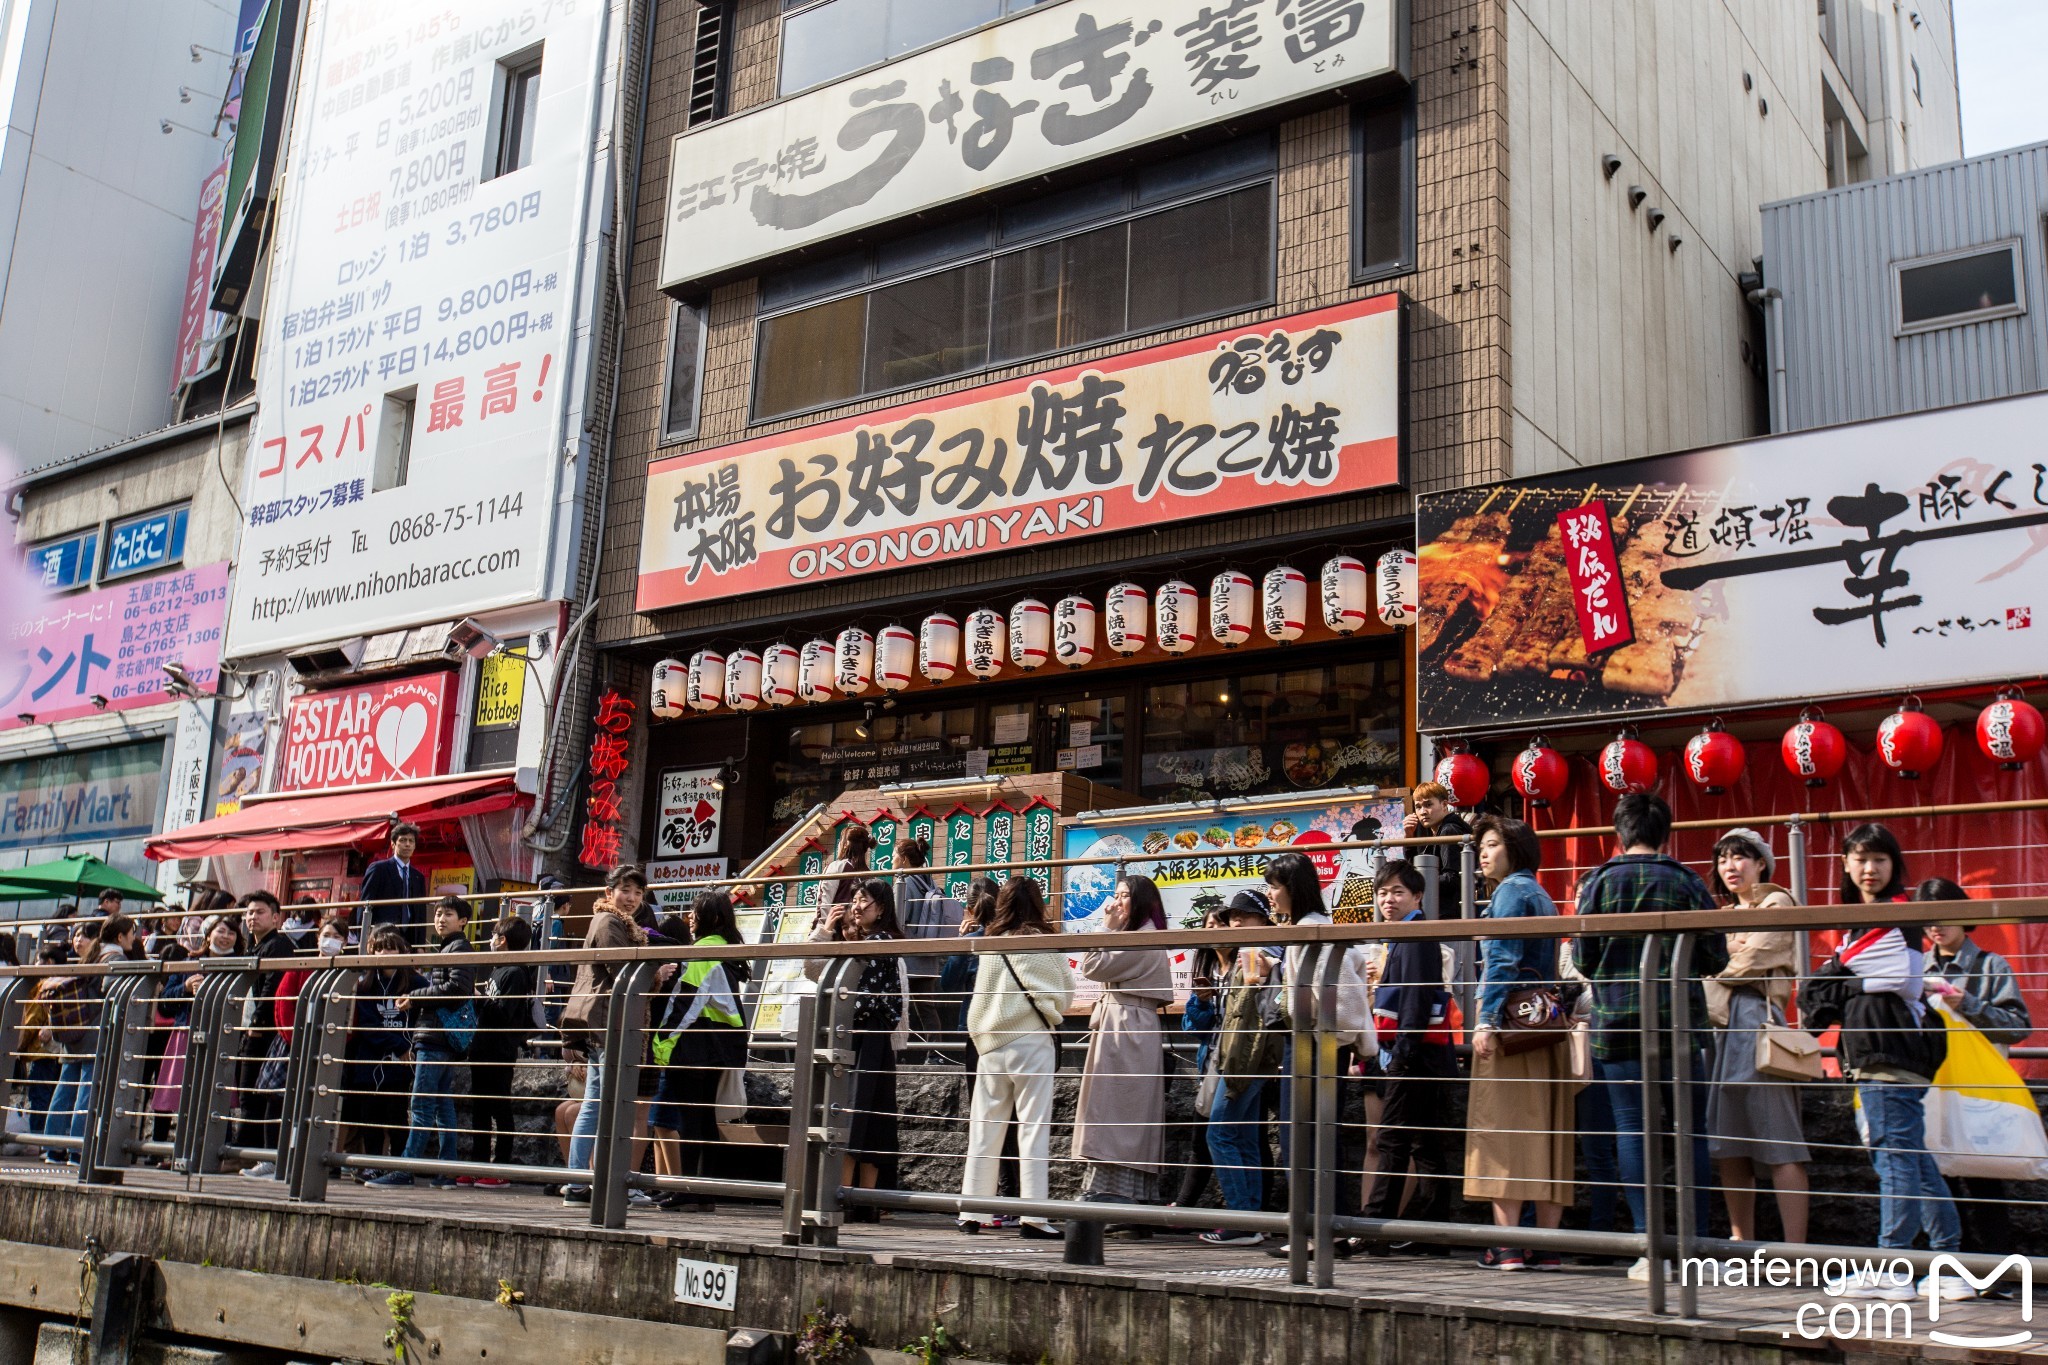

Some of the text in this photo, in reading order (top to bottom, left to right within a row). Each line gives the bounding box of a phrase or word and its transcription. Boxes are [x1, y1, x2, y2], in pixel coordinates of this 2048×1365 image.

[321, 60, 412, 122] 中国自動車道
[1313, 53, 1346, 73] とみ
[397, 67, 475, 126] 5,200円
[751, 12, 1165, 231] うなぎ
[1210, 87, 1241, 107] ひし
[334, 138, 467, 235] 土日祝 7,800円
[677, 135, 827, 222] 江戸焼
[336, 190, 542, 287] ロッジ 1泊 3,780円
[381, 305, 422, 339] 平日
[258, 405, 373, 479] コスパ
[768, 376, 1126, 540] お好み焼
[1139, 403, 1340, 497] たこ焼
[250, 477, 366, 528] 幹部スタッフ募集
[672, 464, 741, 533] 本場
[1663, 497, 1813, 557] 道頓堀
[110, 522, 165, 570] たばこ
[258, 535, 332, 577] 予約受付
[388, 491, 524, 546] 0868-75-1144
[687, 512, 757, 582] 大阪
[789, 497, 1105, 581] OKONOMIYAKI
[42, 547, 63, 586] 酒
[127, 573, 196, 606] 玉屋町本店
[251, 547, 521, 623] http://www.nihonbaracc.com
[1323, 560, 1344, 627] 焼きそば
[1381, 552, 1405, 621] 焼きうどん
[1566, 513, 1618, 641] 秘伝だれ
[120, 614, 191, 645] 島之内支店
[124, 586, 227, 621] 06-6212-3013
[1010, 604, 1024, 661] たこ焼き
[1057, 600, 1077, 657] 串かつ
[1108, 585, 1127, 646] どて焼き
[1159, 585, 1179, 647] とんぺい焼き
[1212, 575, 1231, 638] ホルモン焼き
[1265, 570, 1286, 635] モダン焼き
[118, 627, 221, 660] 06-6765-1306
[801, 642, 819, 696] 生ビール
[840, 631, 862, 686] おおきに
[974, 611, 995, 671] ねぎ焼き
[371, 684, 438, 716] SARANG
[482, 677, 508, 699] Rice
[727, 652, 742, 705] ハイボール
[293, 692, 373, 743] 5STAR
[479, 700, 519, 722] Hotdog
[286, 735, 374, 787] HOTDOG
[844, 750, 876, 759] Welcome
[2, 784, 132, 844] FamilyMart
[184, 756, 203, 824] 大阪下町
[702, 1270, 726, 1301] 99
